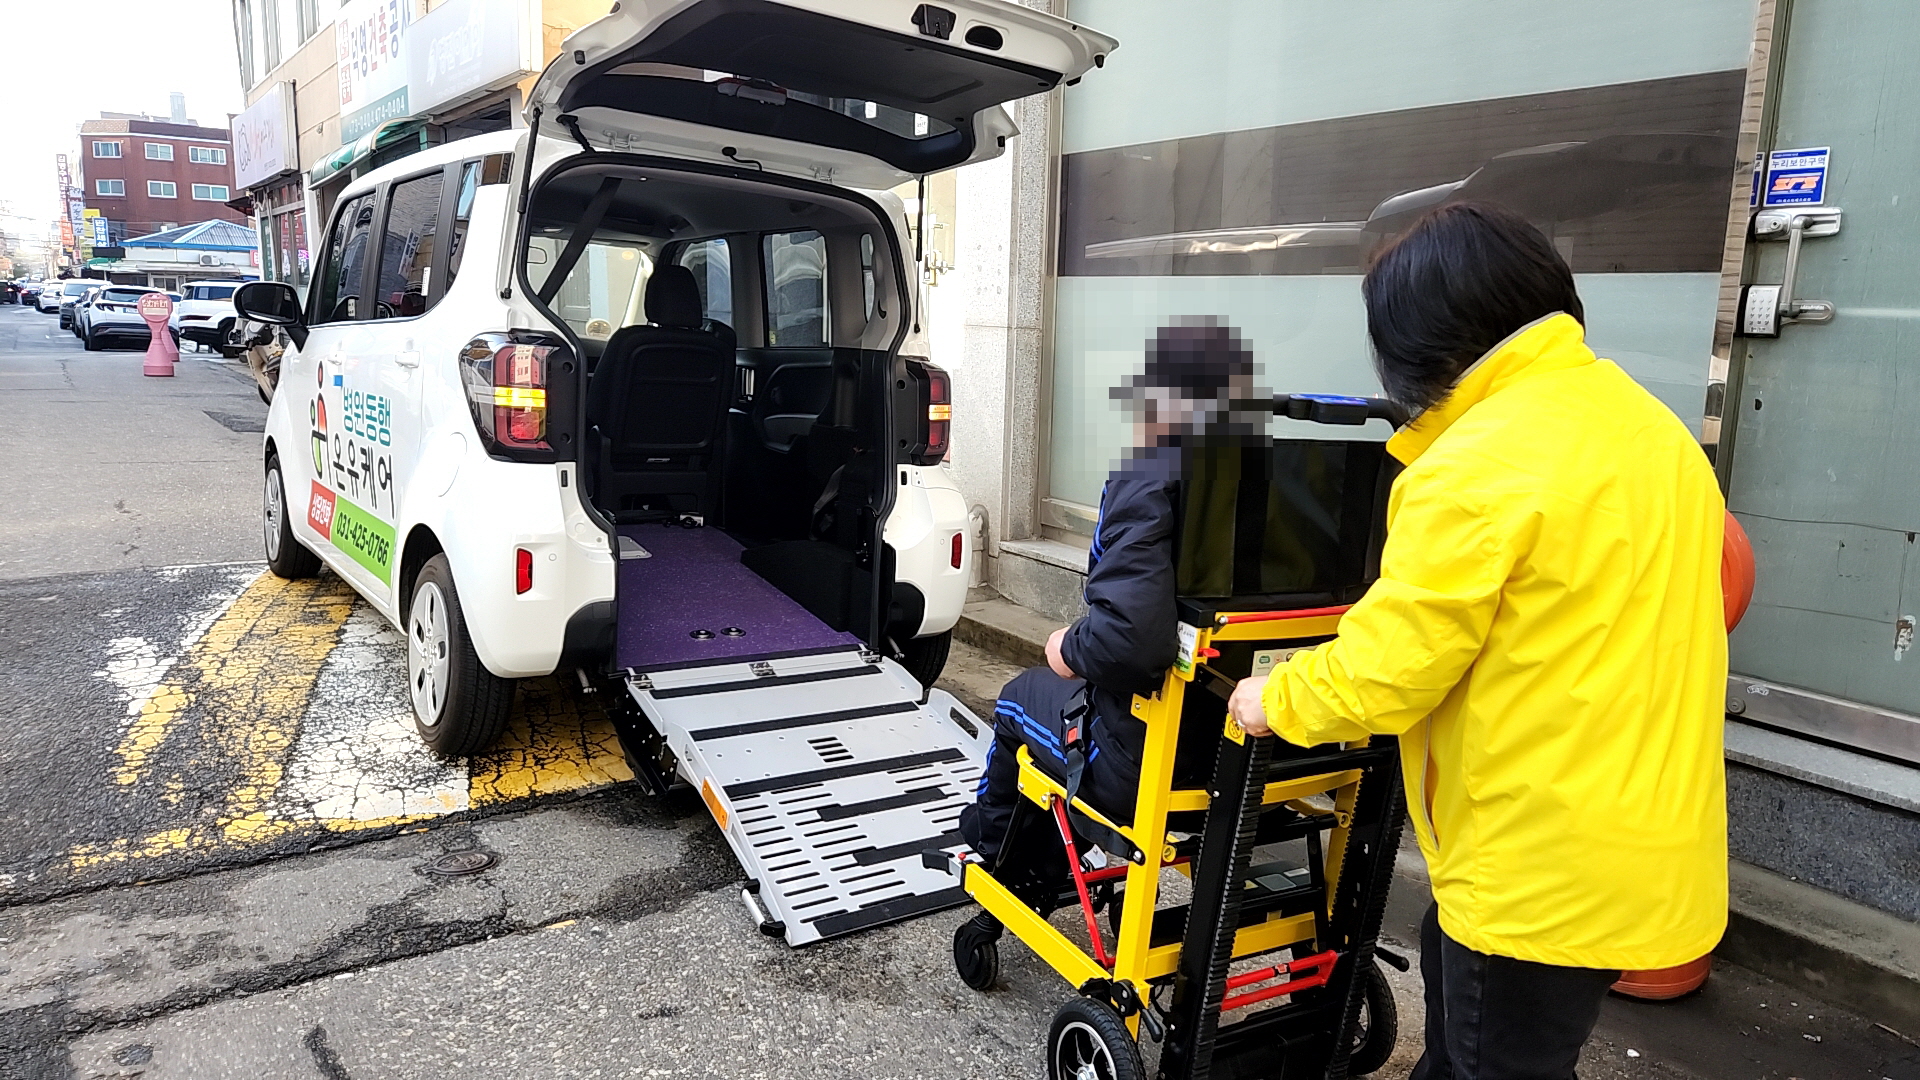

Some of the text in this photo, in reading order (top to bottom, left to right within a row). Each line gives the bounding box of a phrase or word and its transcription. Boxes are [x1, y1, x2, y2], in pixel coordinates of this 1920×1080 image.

[1772, 157, 1826, 168] 누리보안구역
[343, 387, 392, 447] 병원동행
[333, 432, 395, 520] 온유케어
[312, 492, 333, 529] 상담전화
[336, 511, 390, 567] 031-425-0766
